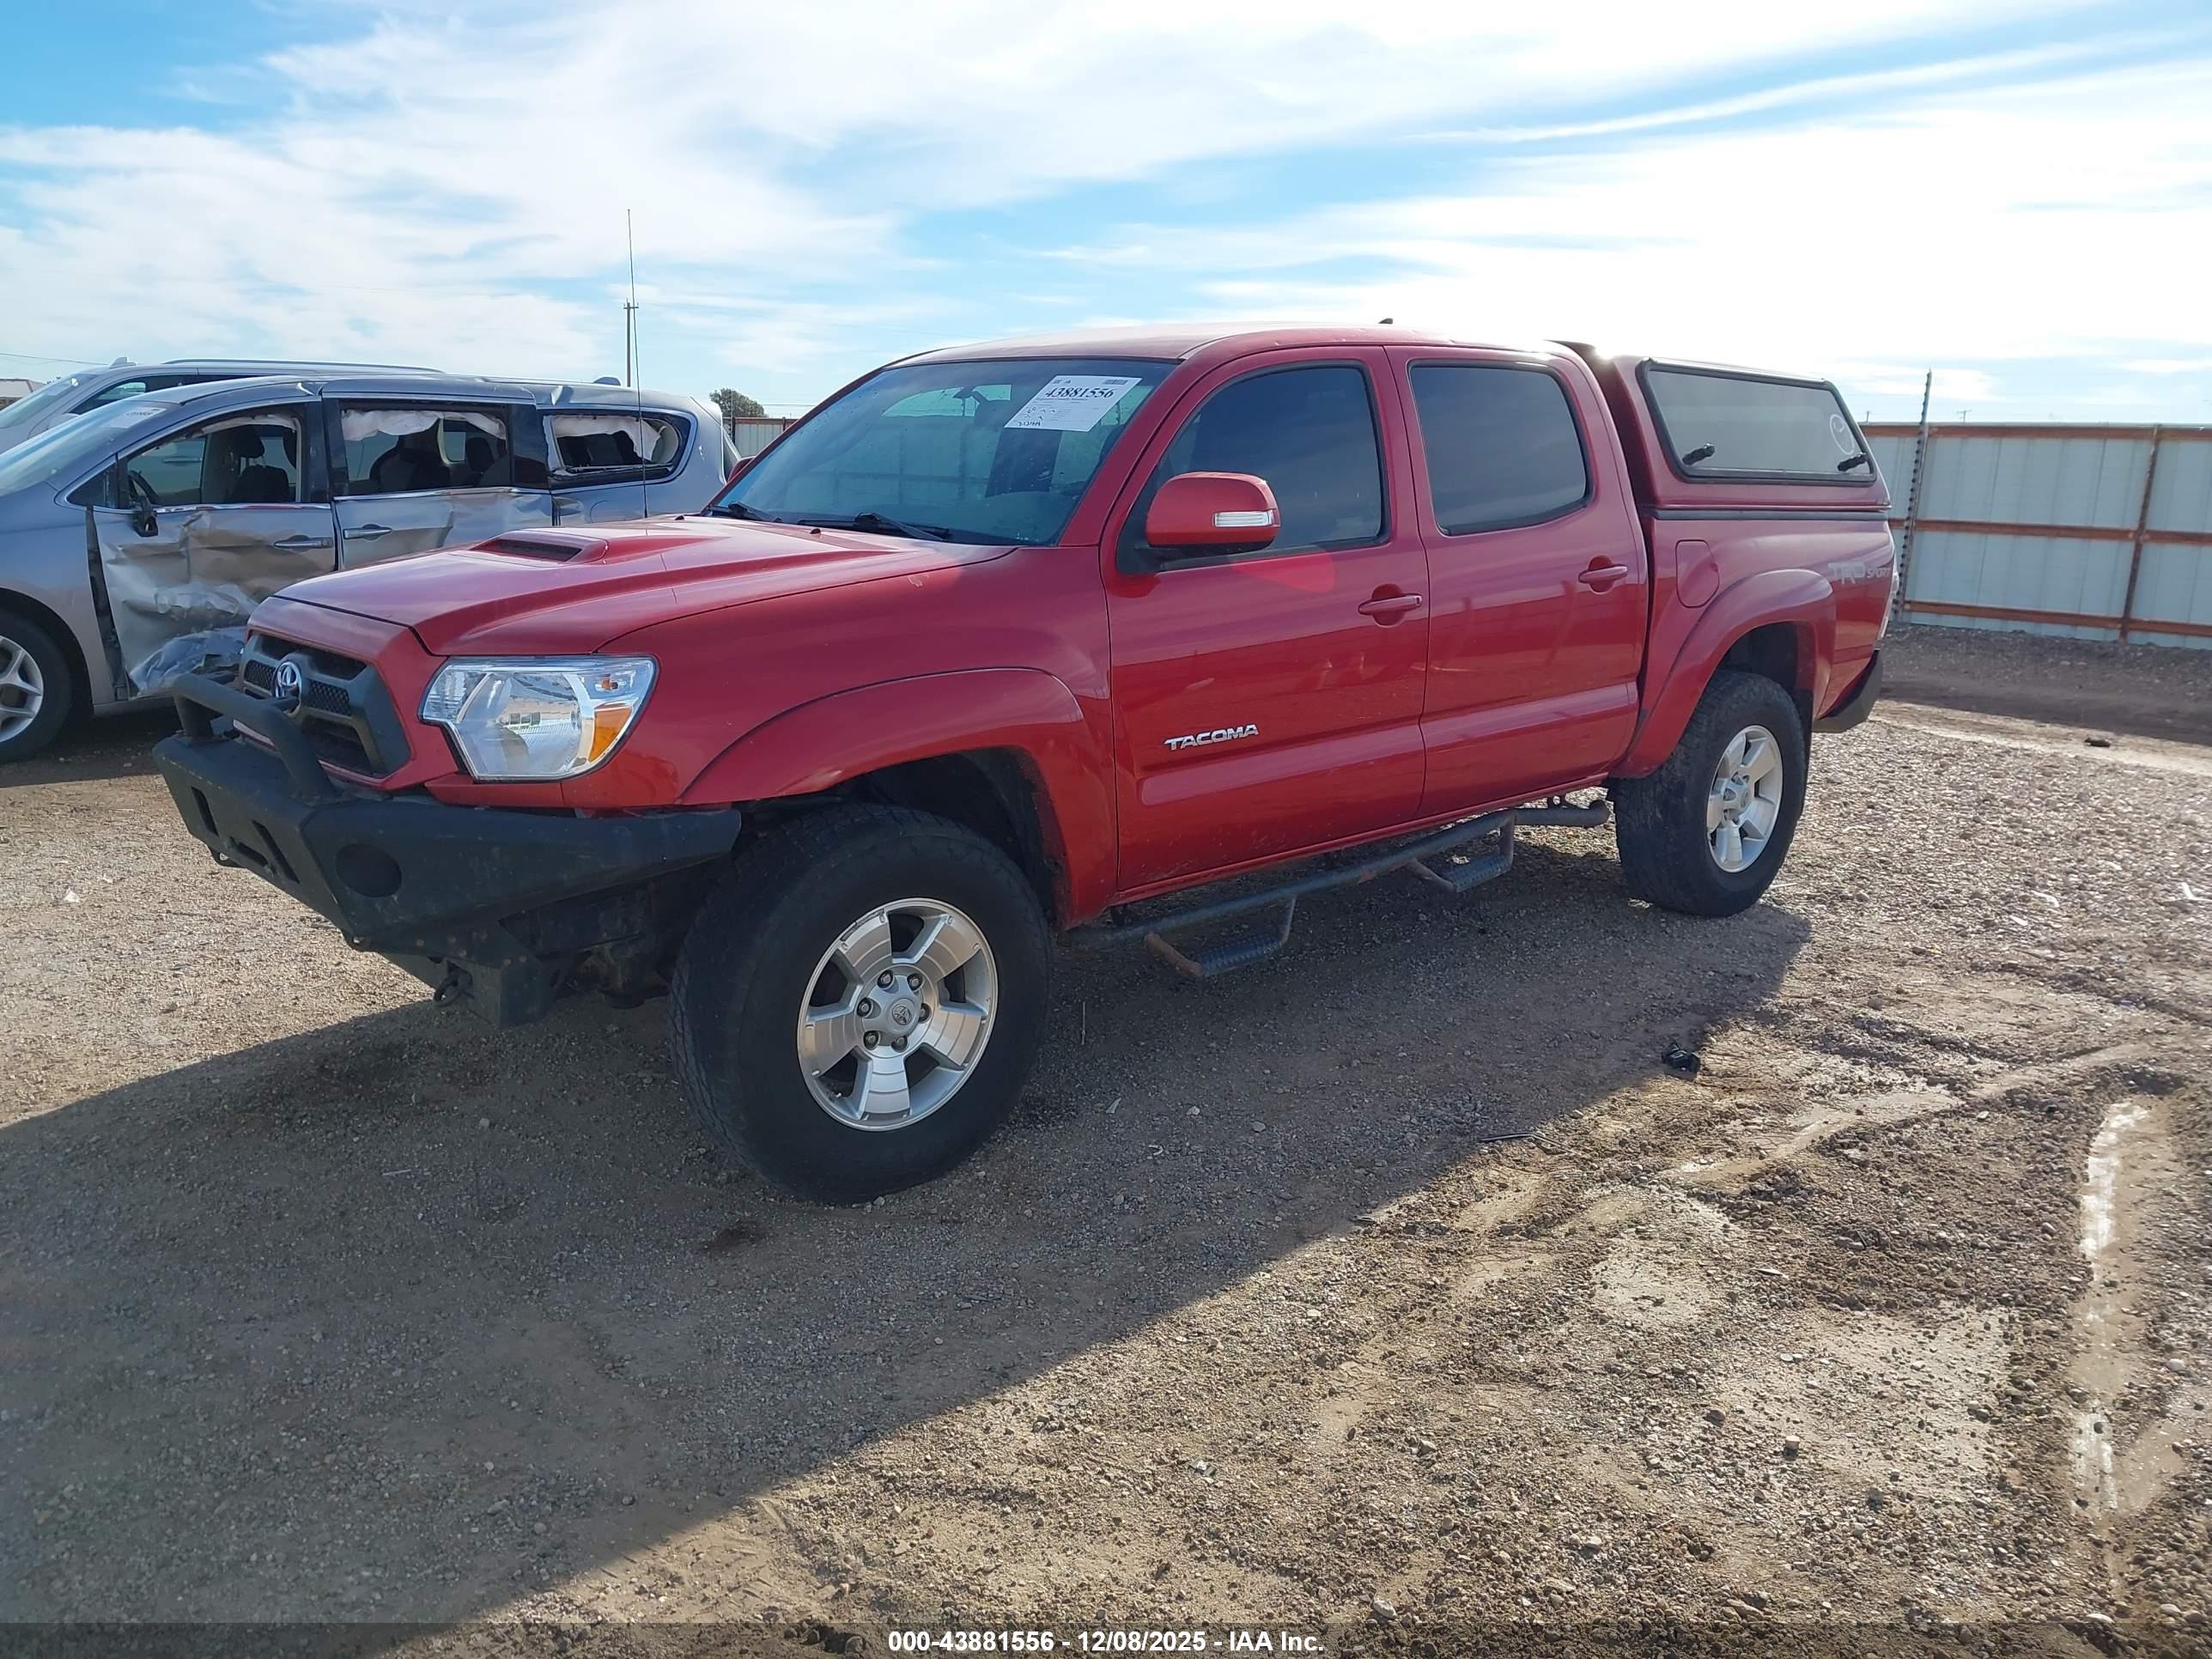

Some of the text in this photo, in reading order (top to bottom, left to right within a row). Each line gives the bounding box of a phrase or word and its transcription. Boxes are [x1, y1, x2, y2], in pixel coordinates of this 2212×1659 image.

[1045, 387, 1115, 398] 43881556
[1827, 562, 1892, 585] TRD SPORT
[1164, 724, 1259, 750] TACOMA
